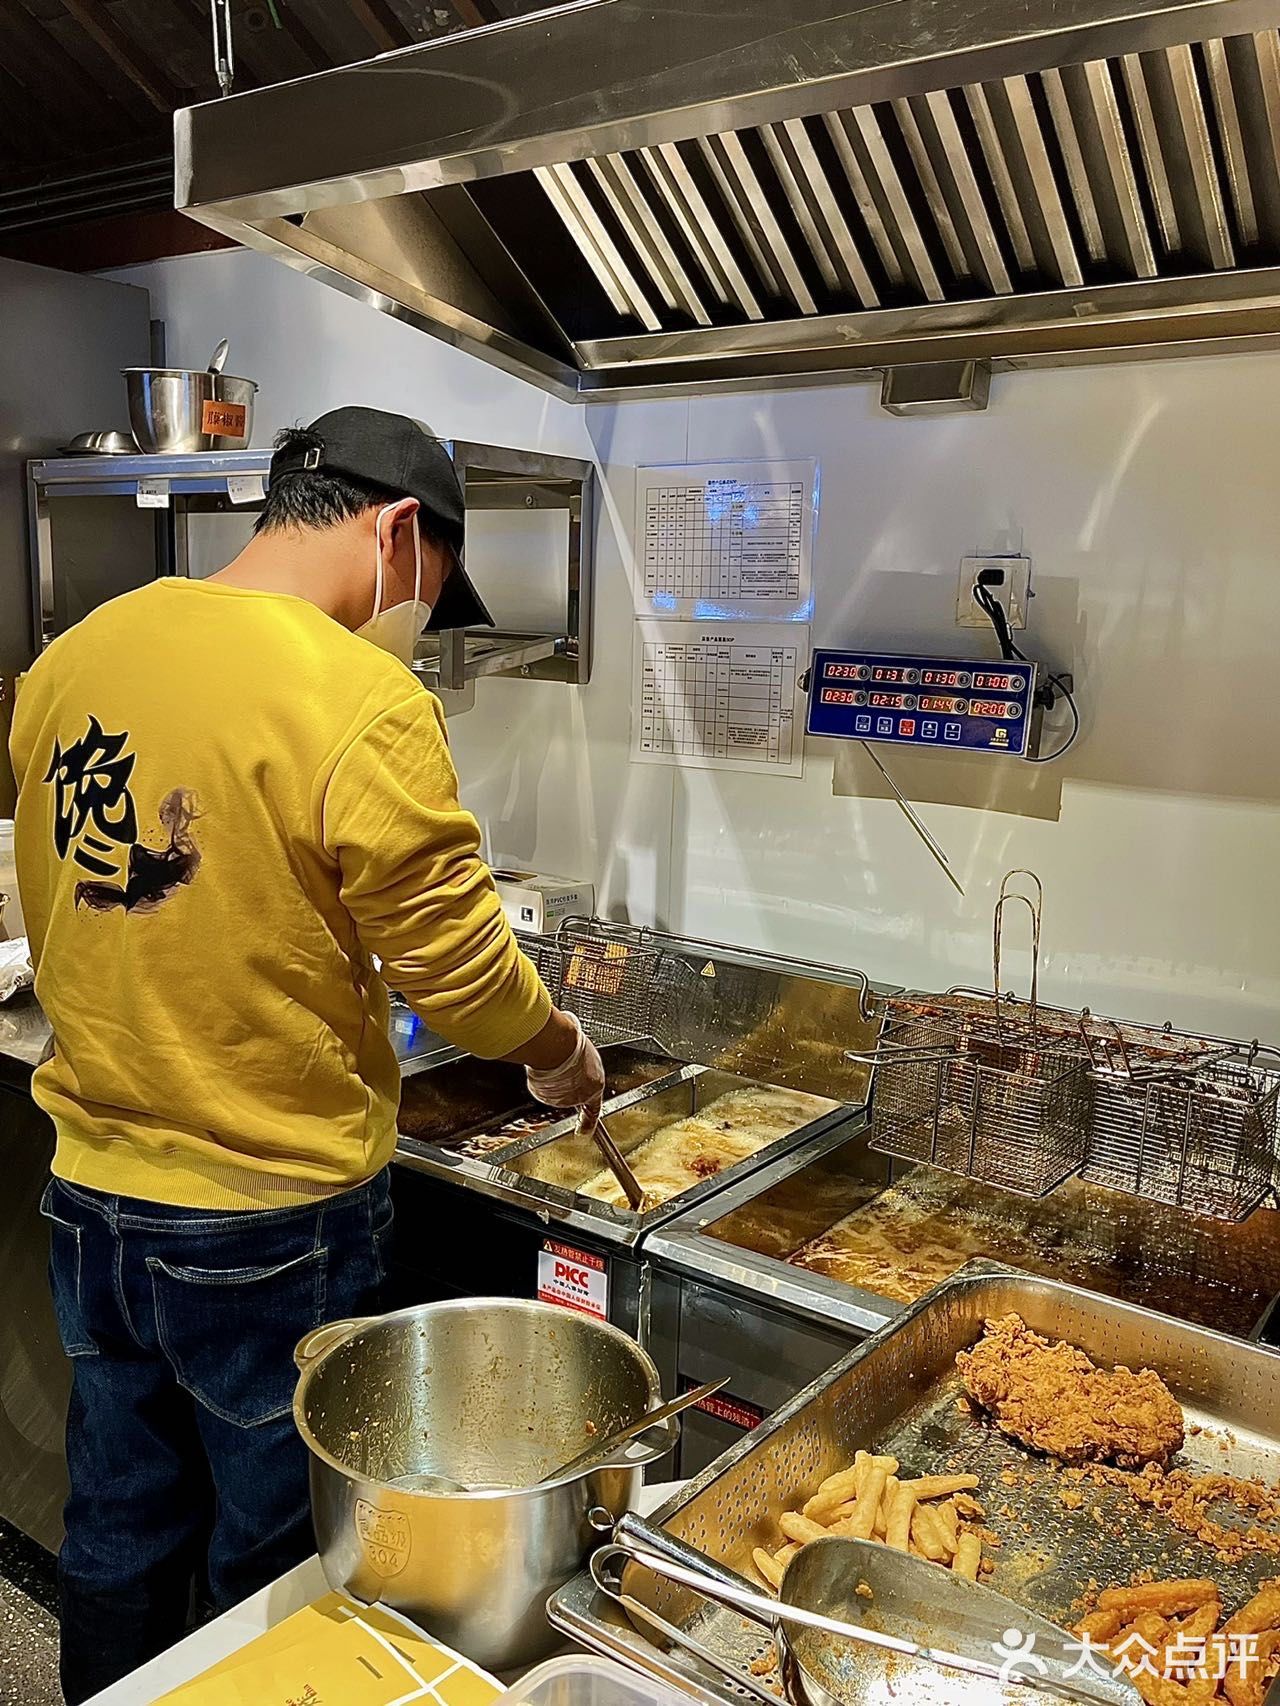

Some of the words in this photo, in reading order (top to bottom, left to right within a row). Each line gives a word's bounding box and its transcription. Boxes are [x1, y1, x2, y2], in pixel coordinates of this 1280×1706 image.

[828, 665, 857, 678] 02:30
[976, 676, 1008, 688] 01:00
[825, 690, 854, 703] 02:30
[973, 702, 1006, 715] 02:00
[555, 1261, 589, 1289] PICC
